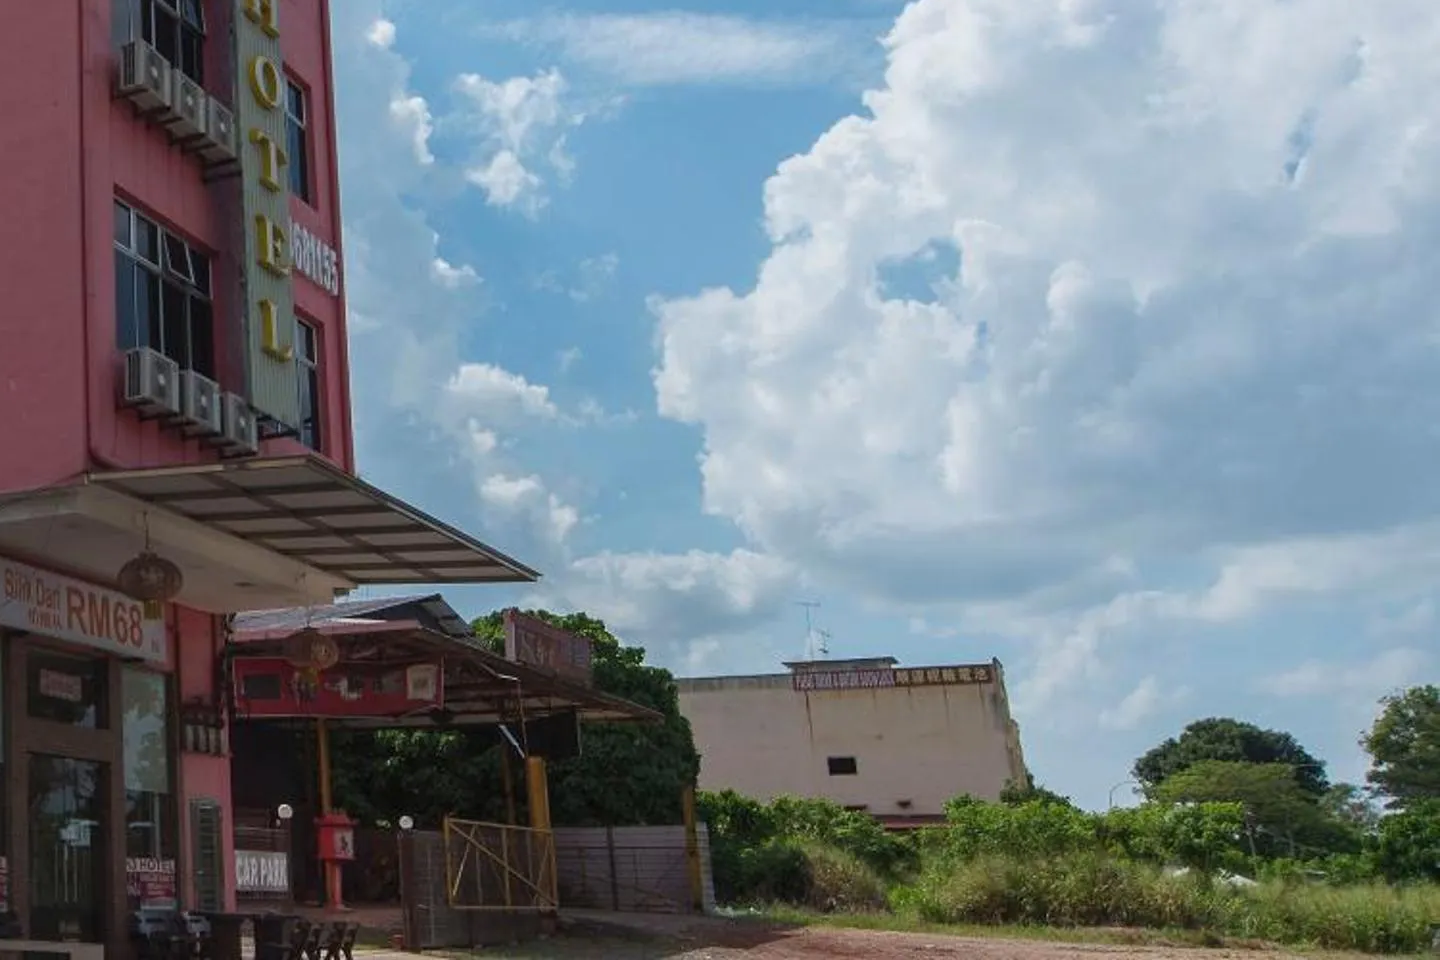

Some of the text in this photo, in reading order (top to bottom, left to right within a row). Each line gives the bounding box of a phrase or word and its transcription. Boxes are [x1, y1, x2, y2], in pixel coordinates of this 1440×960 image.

[66, 586, 143, 649] RM68
[236, 856, 288, 888] CAR PARK
